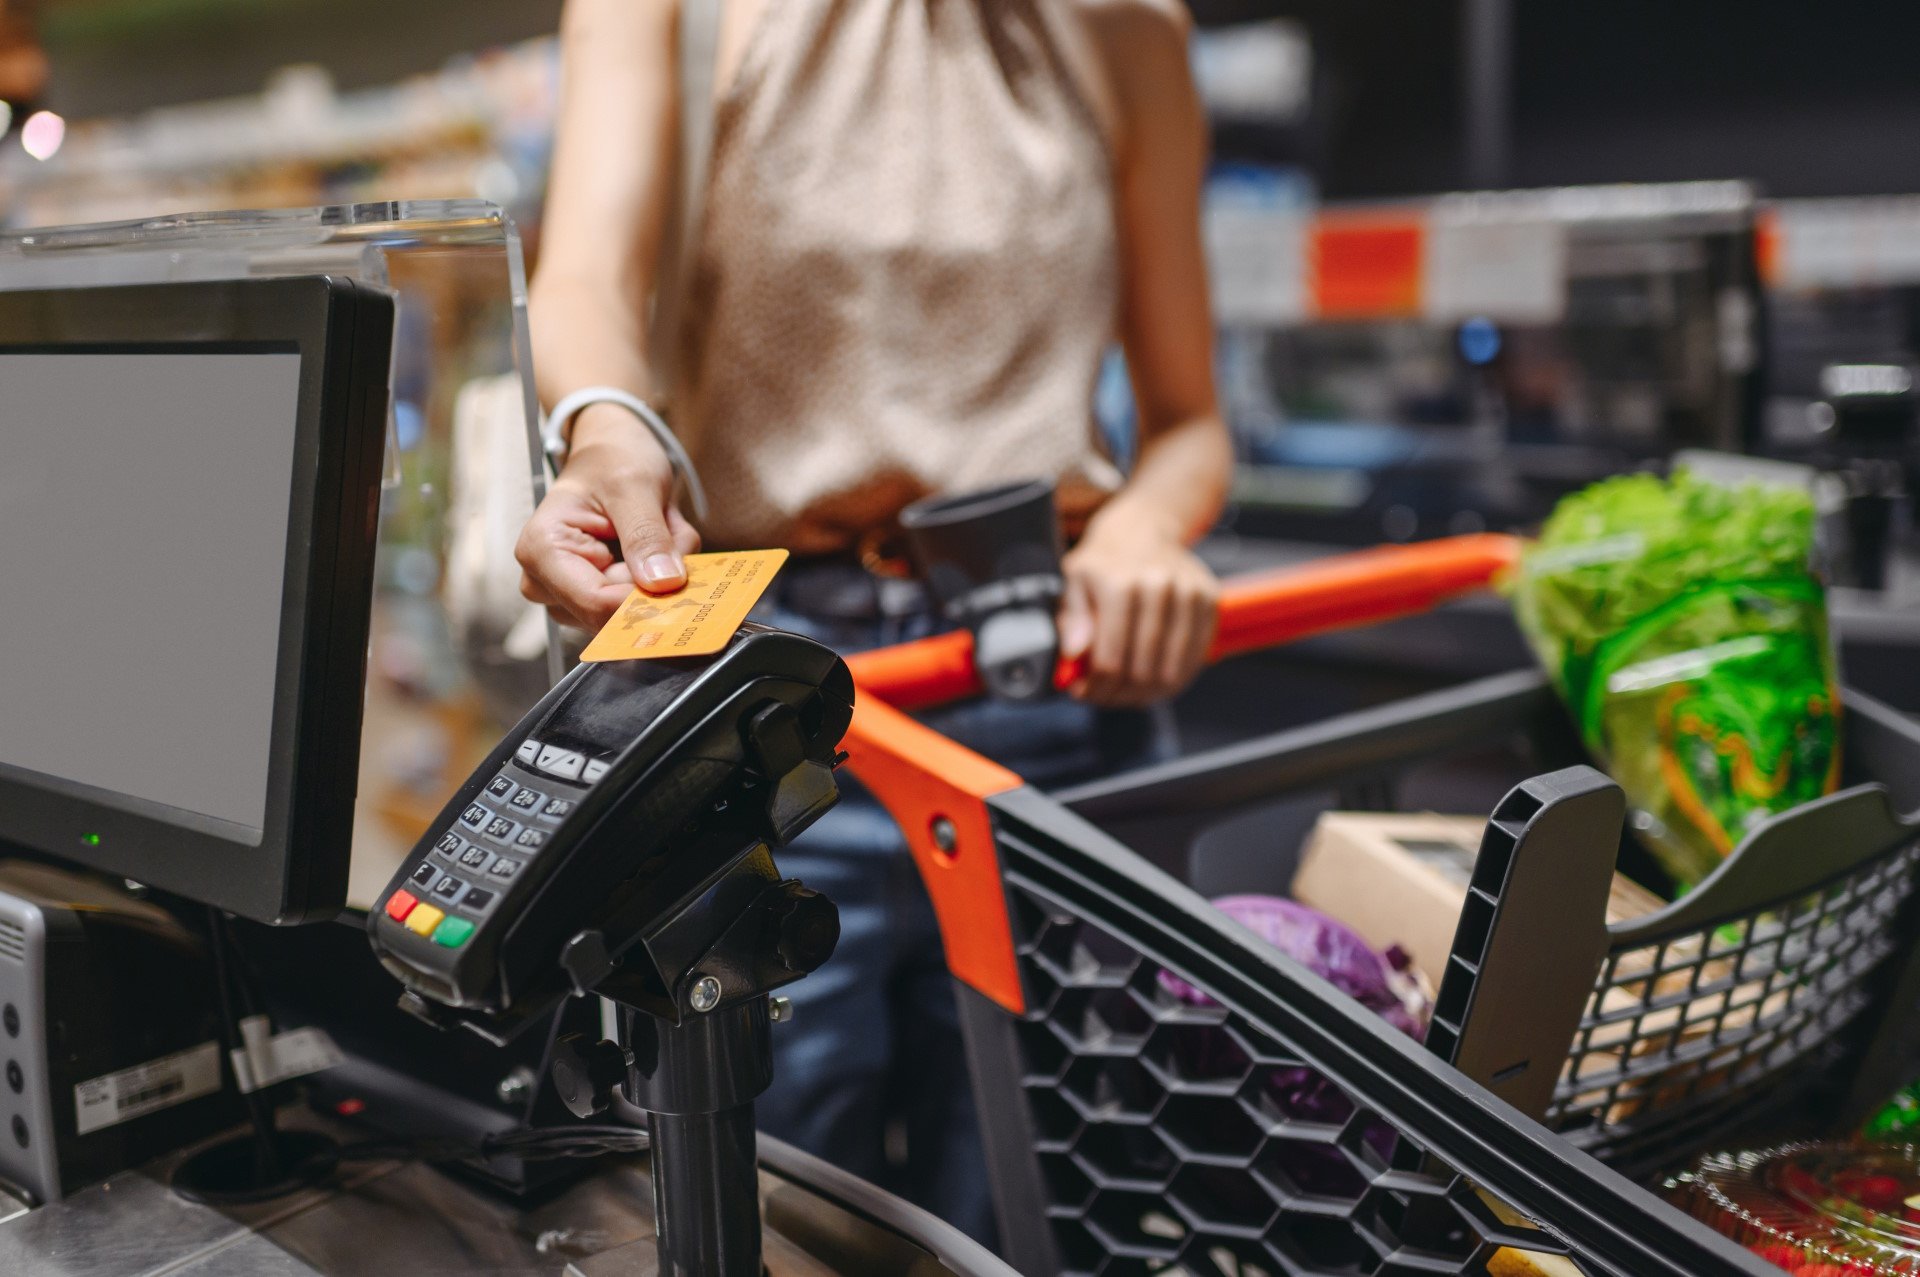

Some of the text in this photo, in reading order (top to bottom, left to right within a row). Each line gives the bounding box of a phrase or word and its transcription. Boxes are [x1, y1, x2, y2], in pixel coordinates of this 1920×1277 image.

[490, 778, 503, 790] 1
[513, 790, 529, 804] 2
[464, 807, 477, 820] 4
[545, 800, 561, 814] 3
[488, 818, 503, 833] 5
[438, 834, 453, 848] 7
[517, 829, 533, 844] 6
[462, 847, 478, 862] 8
[413, 864, 429, 878] F
[491, 859, 507, 873] 9
[436, 876, 452, 891] 0
